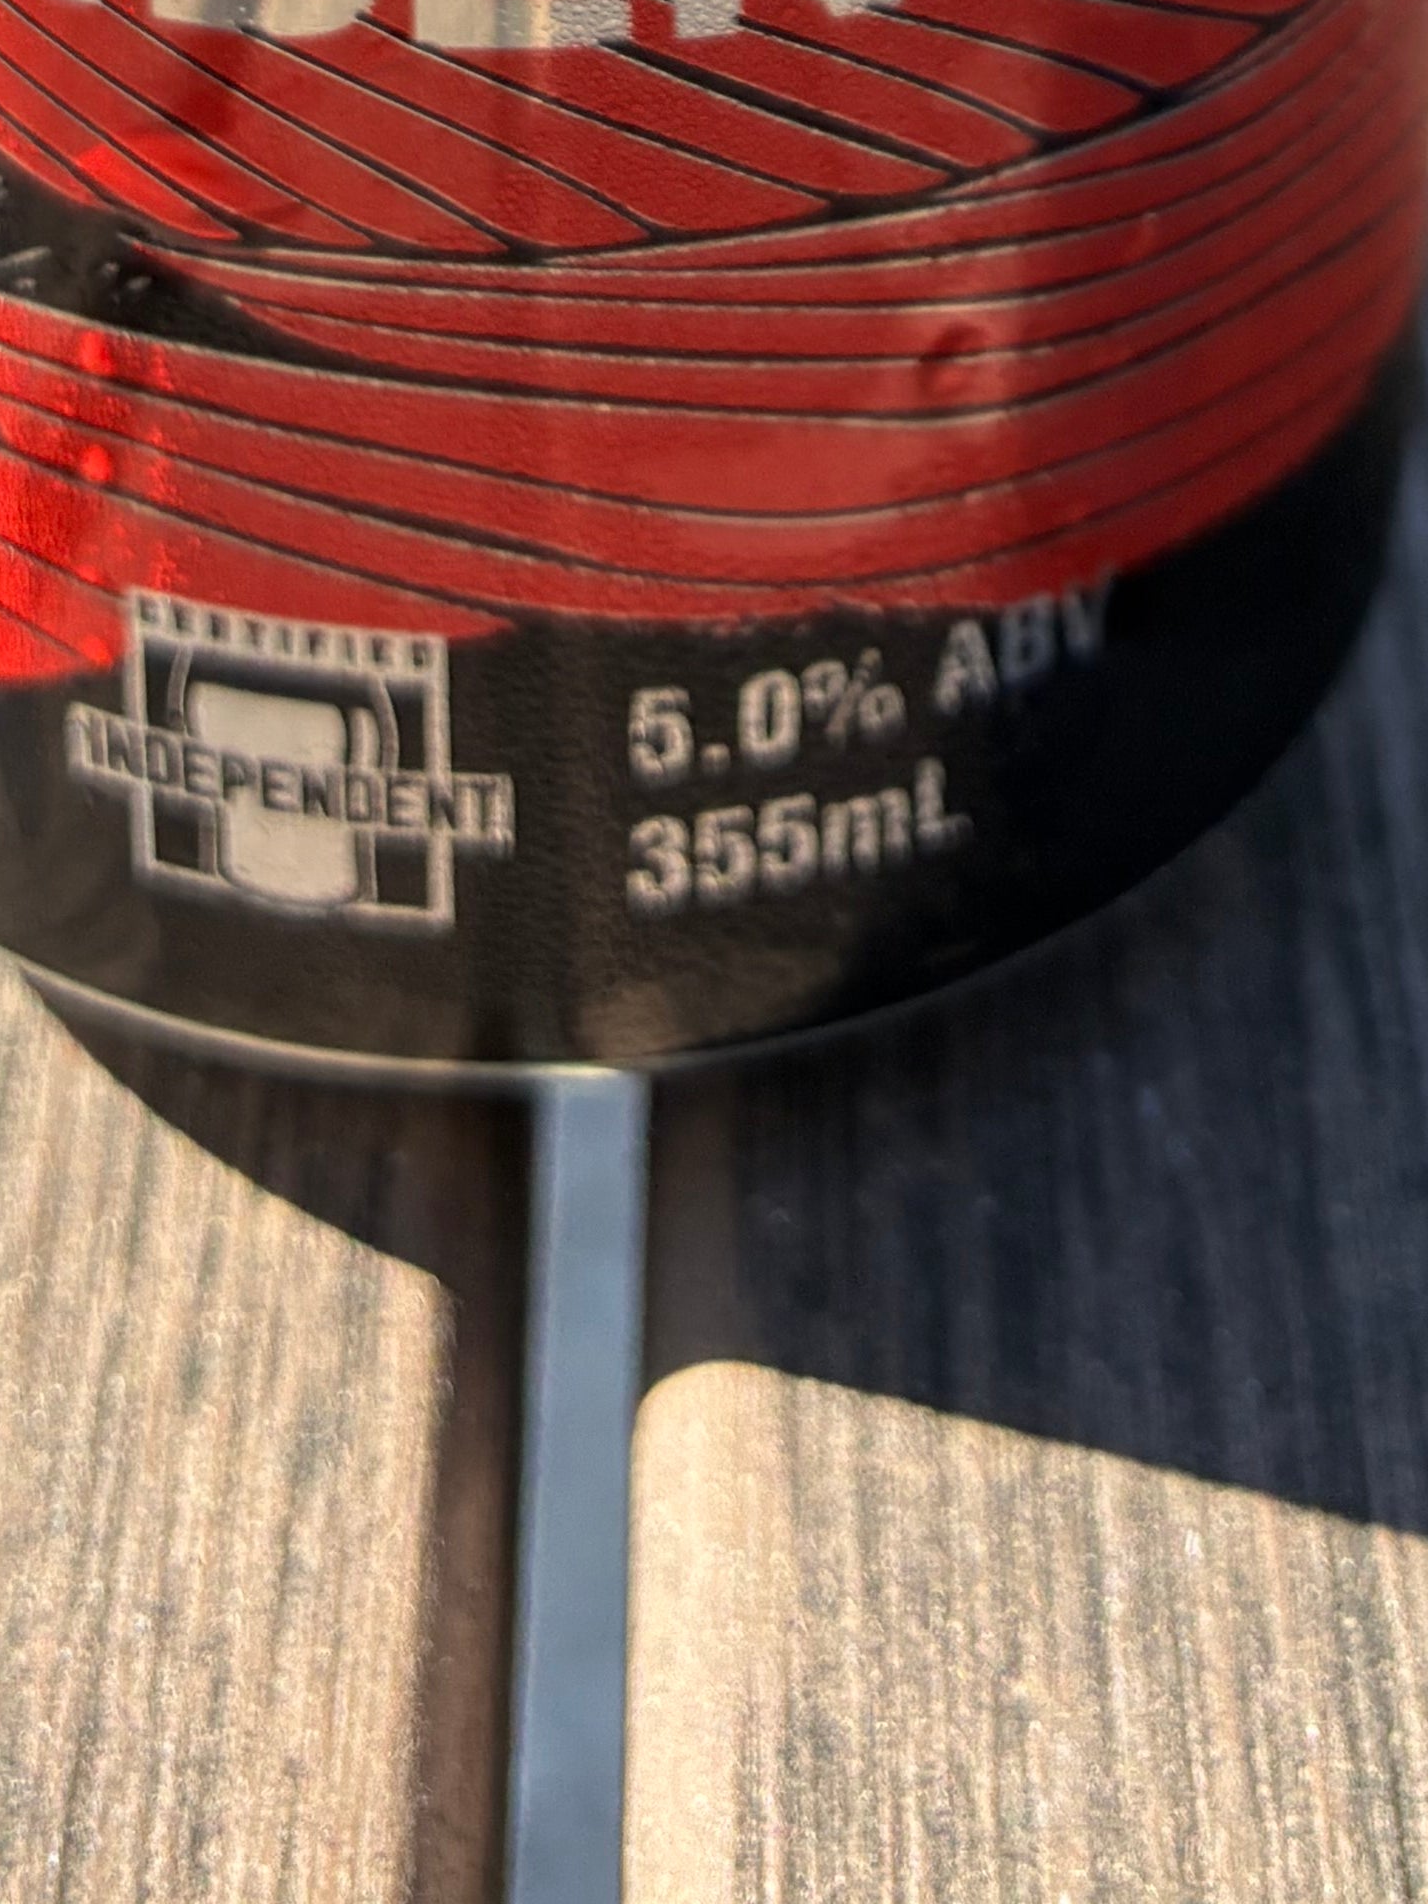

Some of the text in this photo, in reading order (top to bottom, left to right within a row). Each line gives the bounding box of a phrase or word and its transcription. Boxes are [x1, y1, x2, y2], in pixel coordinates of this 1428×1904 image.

[628, 567, 1114, 787] 5.0% ABV
[72, 714, 504, 844] INDEPENDENT
[625, 758, 972, 912] 355mL
